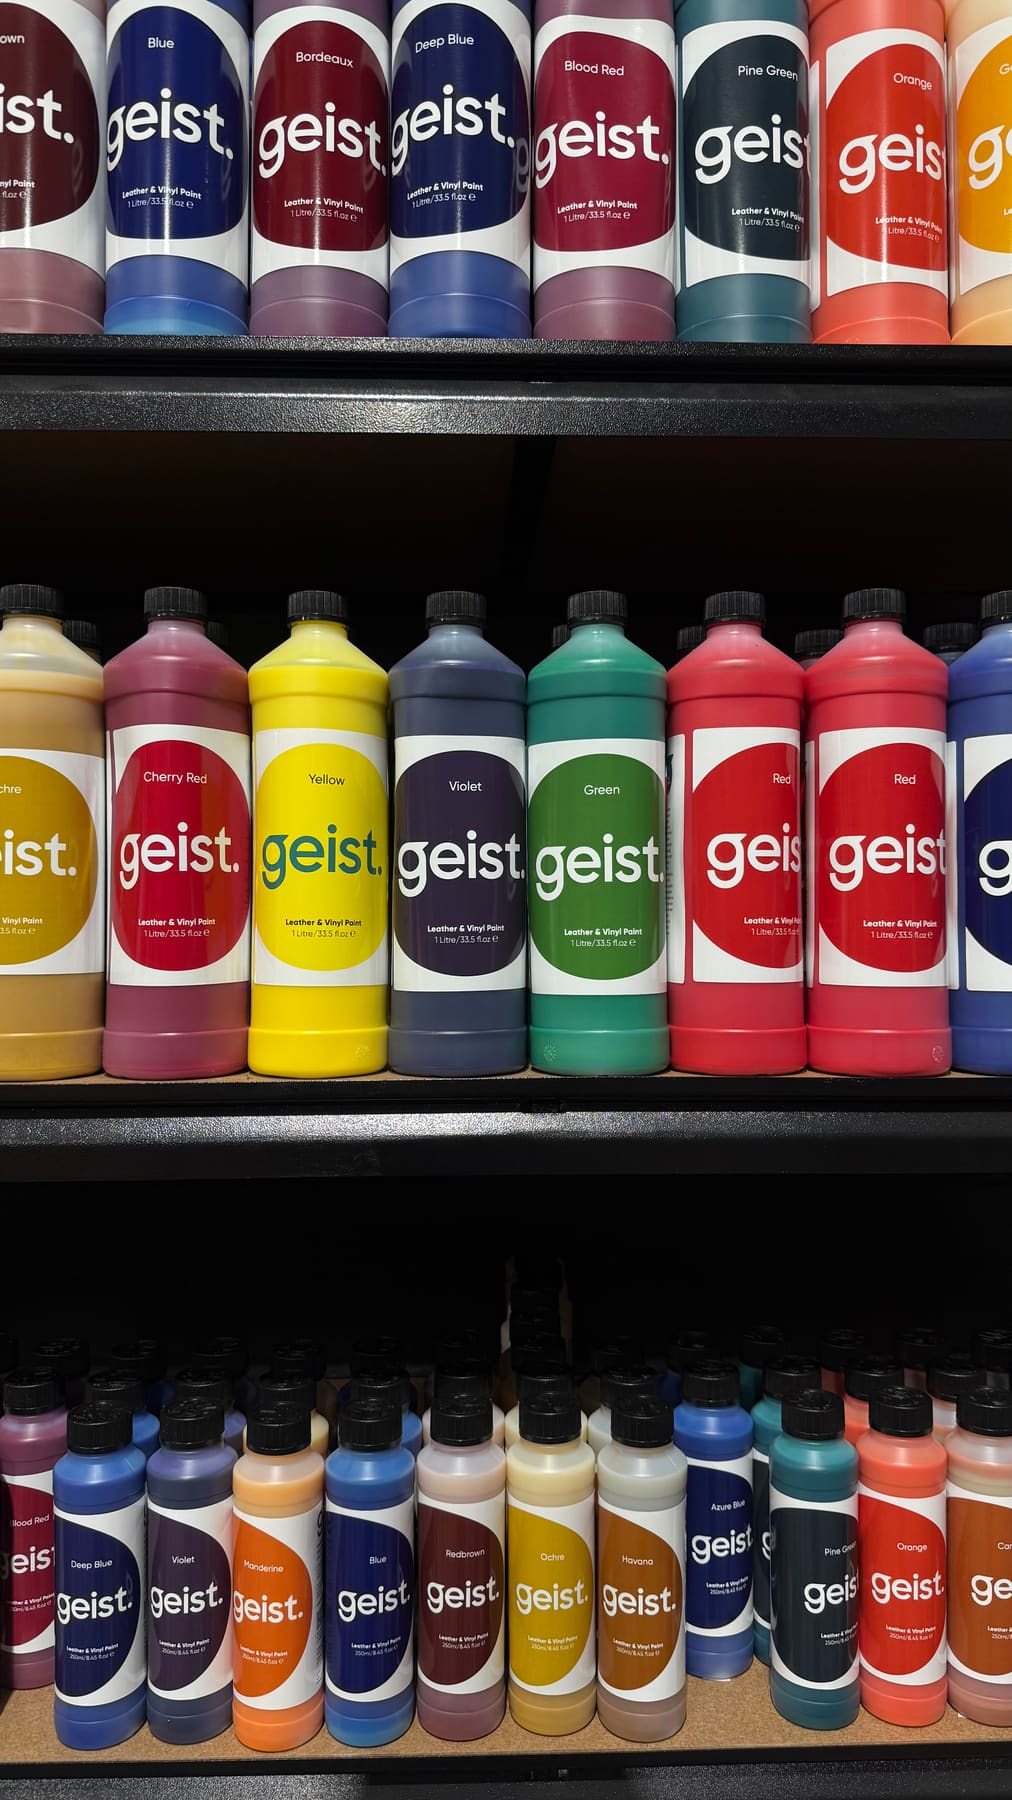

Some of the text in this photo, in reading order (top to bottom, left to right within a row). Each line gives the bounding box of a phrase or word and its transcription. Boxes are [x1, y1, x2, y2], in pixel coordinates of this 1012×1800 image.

[148, 37, 175, 49] Blue
[415, 33, 474, 53] Deep Blue
[295, 52, 353, 68] Bordeaux
[564, 60, 625, 77] Blood Red
[738, 65, 798, 81] Pine Green
[893, 73, 932, 91] Orange
[106, 88, 234, 172] geist.
[391, 83, 515, 177] geist.
[258, 102, 387, 179] geist.
[535, 111, 670, 190] geist.
[13, 180, 35, 190] Paint
[407, 186, 432, 200] Leather
[440, 181, 462, 191] Vinyl
[462, 181, 484, 191] Paint
[2, 191, 17, 199] fl.oz
[123, 186, 201, 200] Leather & Vinyl Paint
[284, 198, 313, 208] Leather
[323, 197, 343, 207] Vinyl
[344, 202, 364, 214] Paint
[416, 194, 450, 208] Litre/33.5
[450, 193, 467, 201] fl.oz
[557, 200, 638, 214] Leather & Vinyl Paint
[334, 210, 349, 220] fl.oz
[568, 211, 605, 222] Litre/33.5
[606, 211, 622, 219] fl.oz
[731, 208, 763, 216] Leather
[771, 208, 788, 218] Vinyl
[789, 210, 804, 223] Paint
[744, 218, 780, 227] Litre/33.5
[875, 216, 906, 224] Leather
[908, 216, 913, 224] &
[914, 217, 930, 228] Vinyl
[143, 771, 208, 785] Cherry Red
[308, 773, 345, 786] Yellow
[773, 773, 791, 785] Red
[894, 774, 916, 785] Red
[0, 783, 22, 794] chre
[449, 780, 482, 792] Violet
[584, 785, 620, 796] Green
[0, 829, 77, 877] ist.
[119, 821, 240, 890] geist.
[262, 824, 382, 890] geist.
[398, 830, 525, 898] geist.
[535, 833, 664, 901] geist.
[2, 917, 19, 926] Vinyl
[138, 918, 216, 927] Leather & Vinyl Paint
[285, 918, 314, 926] Leather
[324, 919, 342, 928] Vinyl
[343, 919, 362, 927] Paint
[863, 920, 937, 929] Leather & Vinyl Paint
[148, 930, 186, 938] Litre/33.5
[187, 929, 202, 937] fl.oz
[296, 929, 333, 938] Litre/33.5
[427, 925, 458, 933] Leather
[466, 924, 485, 933] Vinyl
[564, 928, 642, 937] Leather & Vinyl Paint
[440, 936, 476, 944] Litre/33.5
[477, 935, 491, 943] fl.oz
[876, 931, 913, 939] Litre/33.5
[914, 931, 928, 939] fl.oz
[576, 939, 611, 948] Litre/33.5
[612, 939, 627, 947] fl.oz
[711, 1499, 746, 1512] Azure Blue
[34, 1514, 50, 1525] Red
[446, 1548, 486, 1559] Redbrown
[824, 1546, 841, 1557] Pine
[897, 1542, 928, 1553] Orange
[171, 1555, 195, 1565] Violet
[369, 1554, 387, 1565] Blue
[540, 1552, 565, 1562] Ochre
[622, 1555, 654, 1566] Havana
[71, 1559, 113, 1571] Deep Blue
[243, 1560, 284, 1574] Manderine
[871, 1570, 944, 1605] geist.
[150, 1581, 223, 1619] geist.
[337, 1578, 410, 1623] geist.
[426, 1575, 500, 1614] geist.
[516, 1578, 588, 1616] geist.
[602, 1583, 676, 1617] geist.
[57, 1585, 133, 1625] geist.
[233, 1590, 303, 1624] geist.
